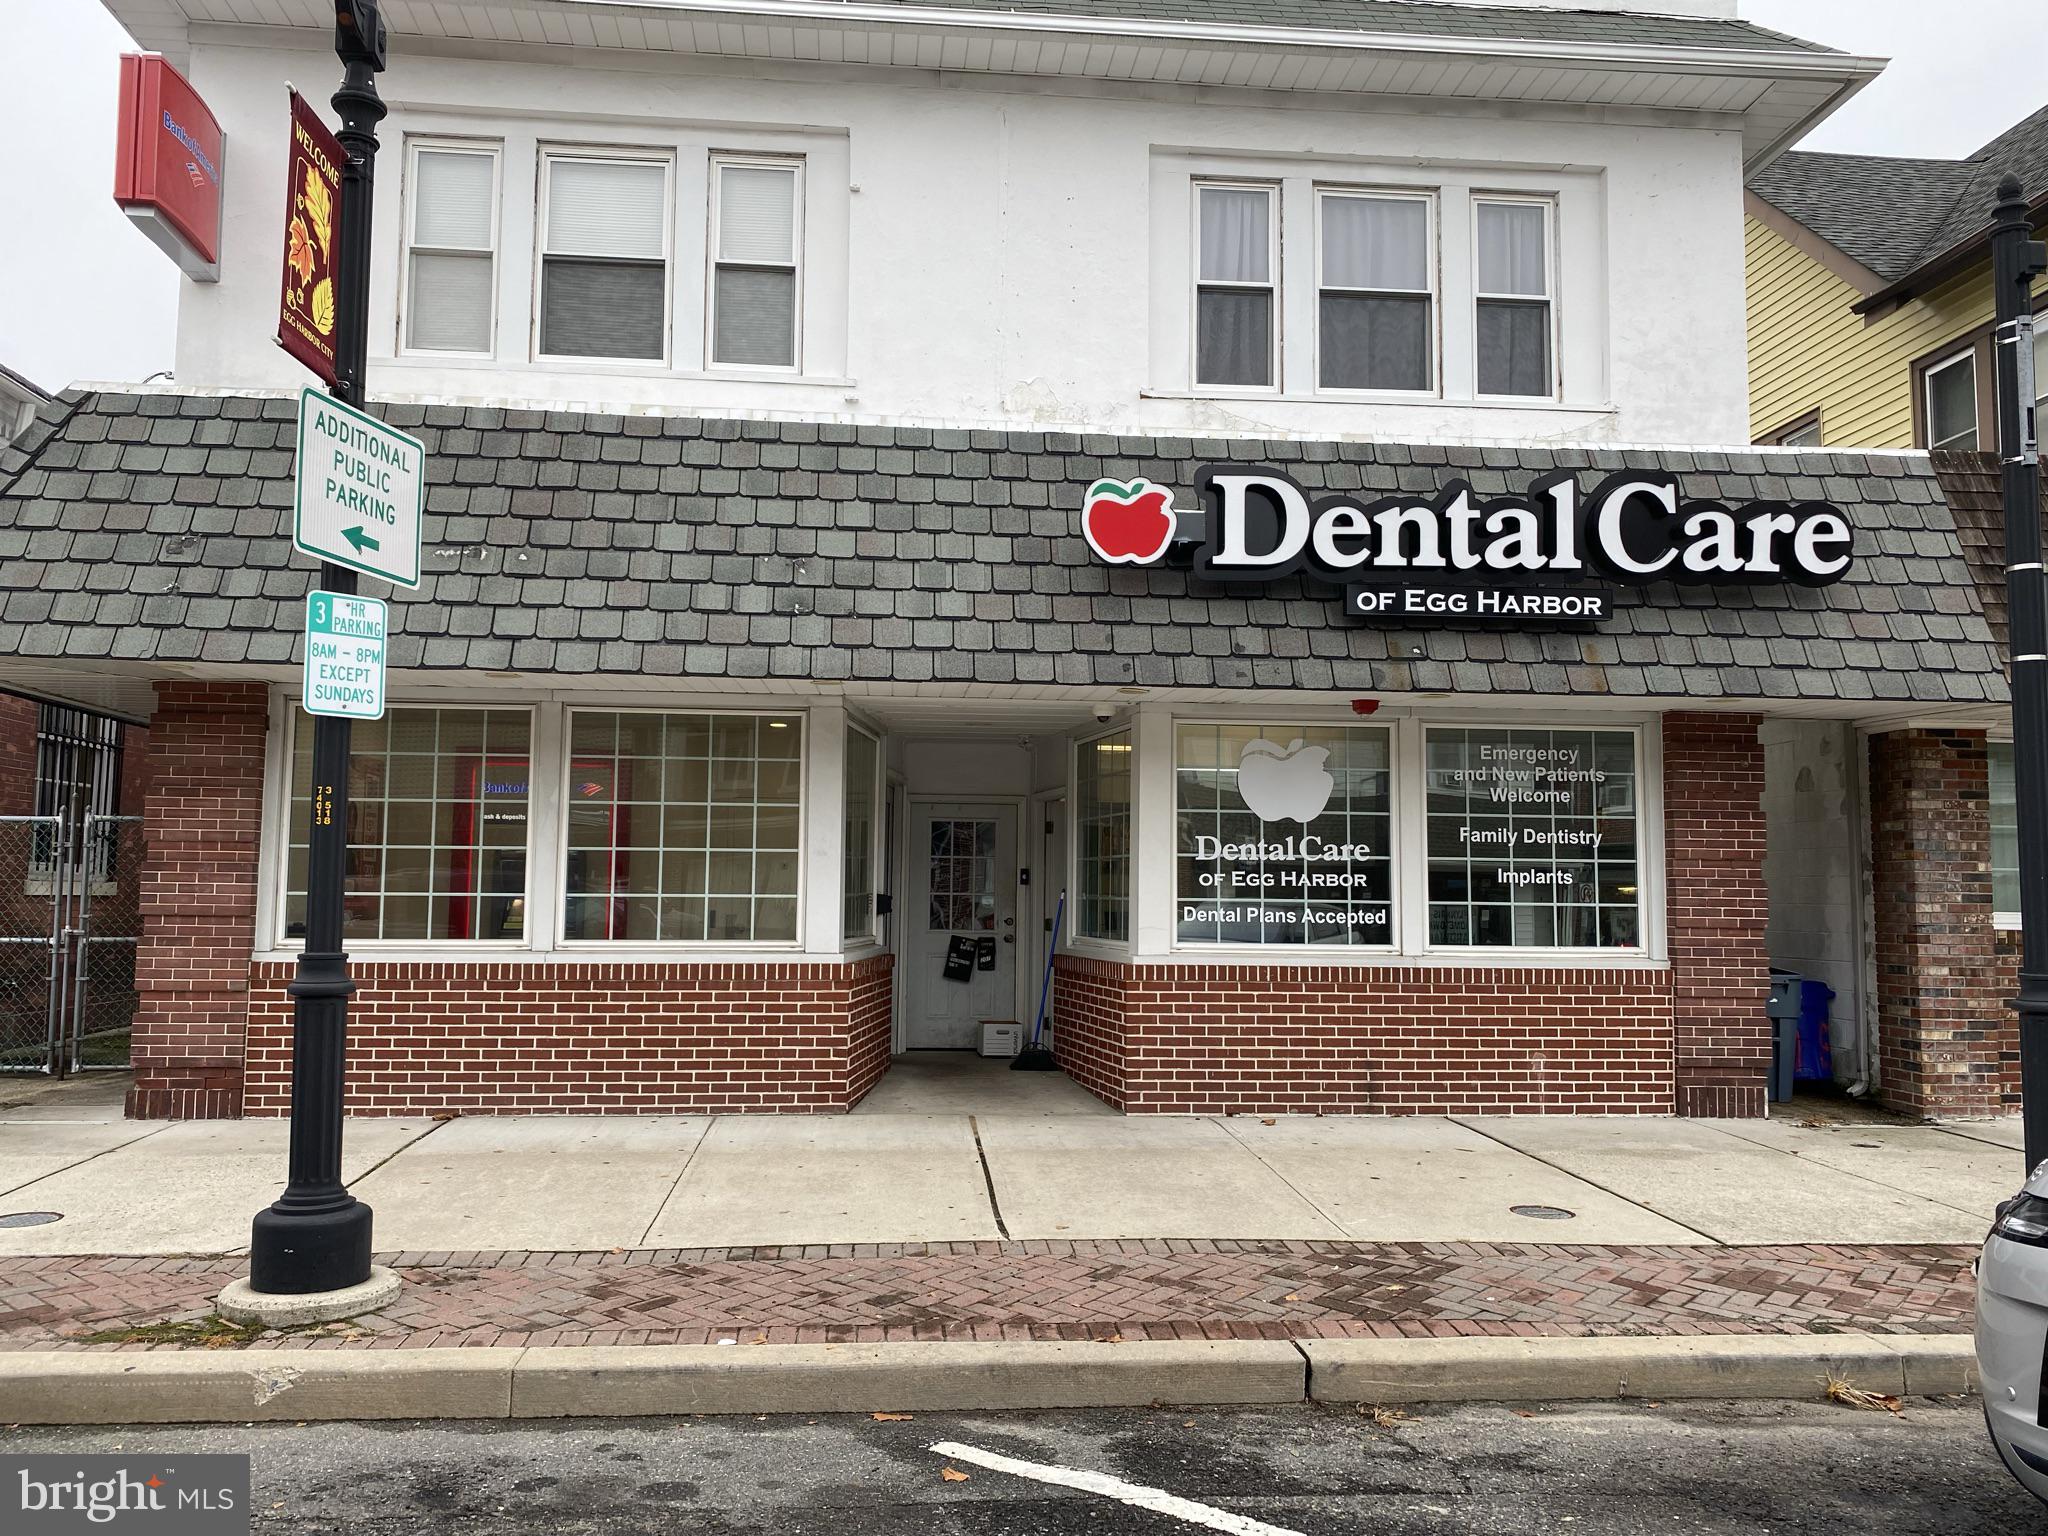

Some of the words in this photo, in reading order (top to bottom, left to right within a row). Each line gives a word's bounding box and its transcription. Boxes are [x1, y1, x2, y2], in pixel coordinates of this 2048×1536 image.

[164, 111, 187, 146] Bank
[296, 120, 340, 190] WELCOME
[283, 309, 296, 327] EGG
[296, 320, 321, 349] HARBOR
[321, 343, 334, 360] CITY
[315, 411, 410, 474] ADDITIONAL
[334, 449, 391, 494] PUBLIC
[326, 478, 396, 526] PARKING
[315, 601, 326, 624] 3
[350, 602, 366, 618] HR
[334, 616, 381, 637] PARKING
[311, 642, 337, 659] 8AM
[356, 647, 380, 664] 8PM
[320, 664, 371, 683] EXCEPT
[314, 684, 374, 704] SUNDAYS
[1480, 745, 1579, 764] Emergency
[1454, 767, 1486, 781] and
[1492, 767, 1529, 782] New
[1535, 767, 1605, 782] Patients
[1490, 787, 1571, 803] Welcome
[502, 813, 526, 821] deposits
[1459, 827, 1518, 846] Family
[1523, 828, 1603, 848] Dentistry
[1497, 868, 1573, 887] Implants
[1183, 906, 1241, 923] Dental
[1247, 907, 1296, 923] Plans
[1301, 908, 1386, 927] Accepted
